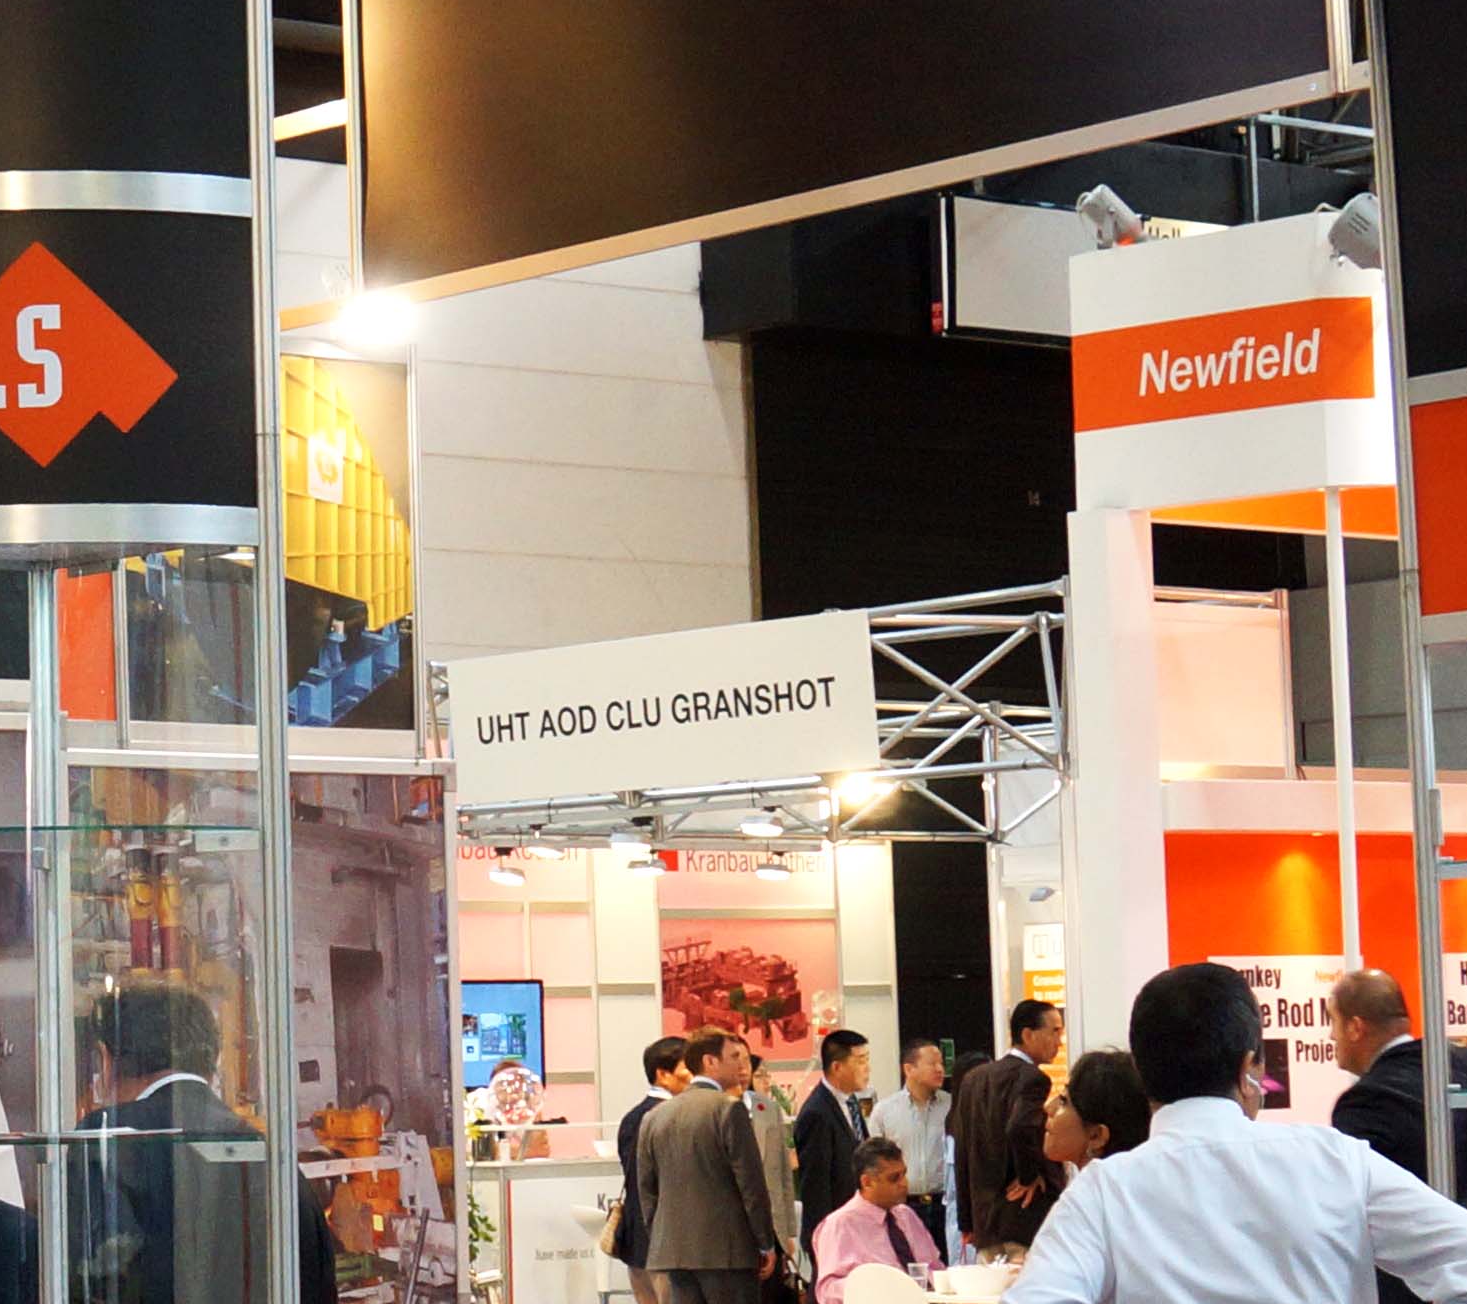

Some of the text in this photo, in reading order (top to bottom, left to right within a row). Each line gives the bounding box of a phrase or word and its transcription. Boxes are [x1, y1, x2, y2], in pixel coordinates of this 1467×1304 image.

[1138, 328, 1320, 398] Newfield
[476, 676, 837, 746] UHT AOD CLU GRANSHOT
[1277, 997, 1315, 1028] Rod
